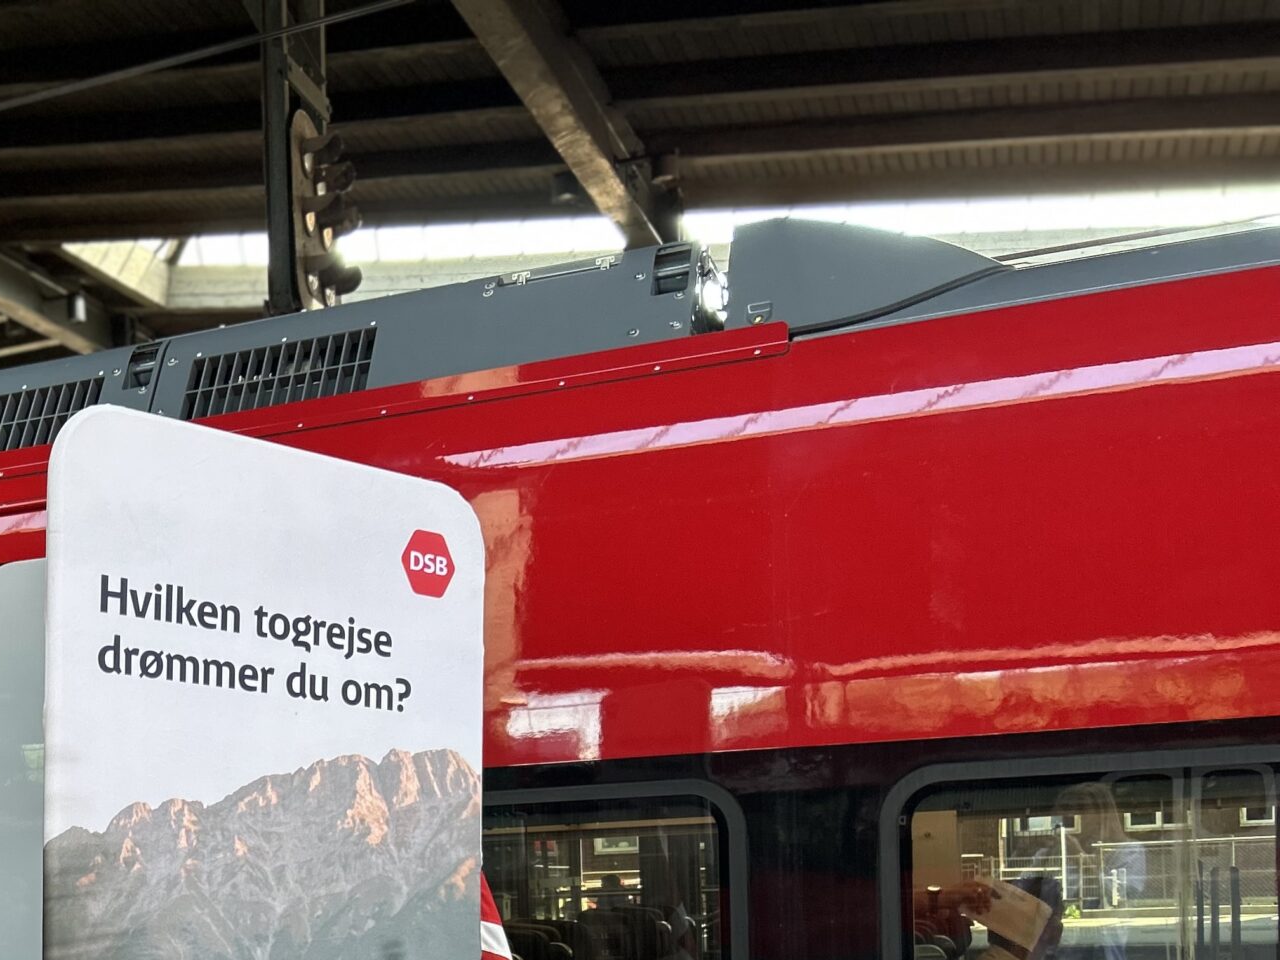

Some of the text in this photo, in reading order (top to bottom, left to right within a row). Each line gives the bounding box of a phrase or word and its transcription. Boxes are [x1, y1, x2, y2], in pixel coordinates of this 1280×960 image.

[409, 550, 448, 576] DSB
[100, 574, 393, 660] Hvilken togrejse
[97, 634, 412, 713] drømmer du om?
